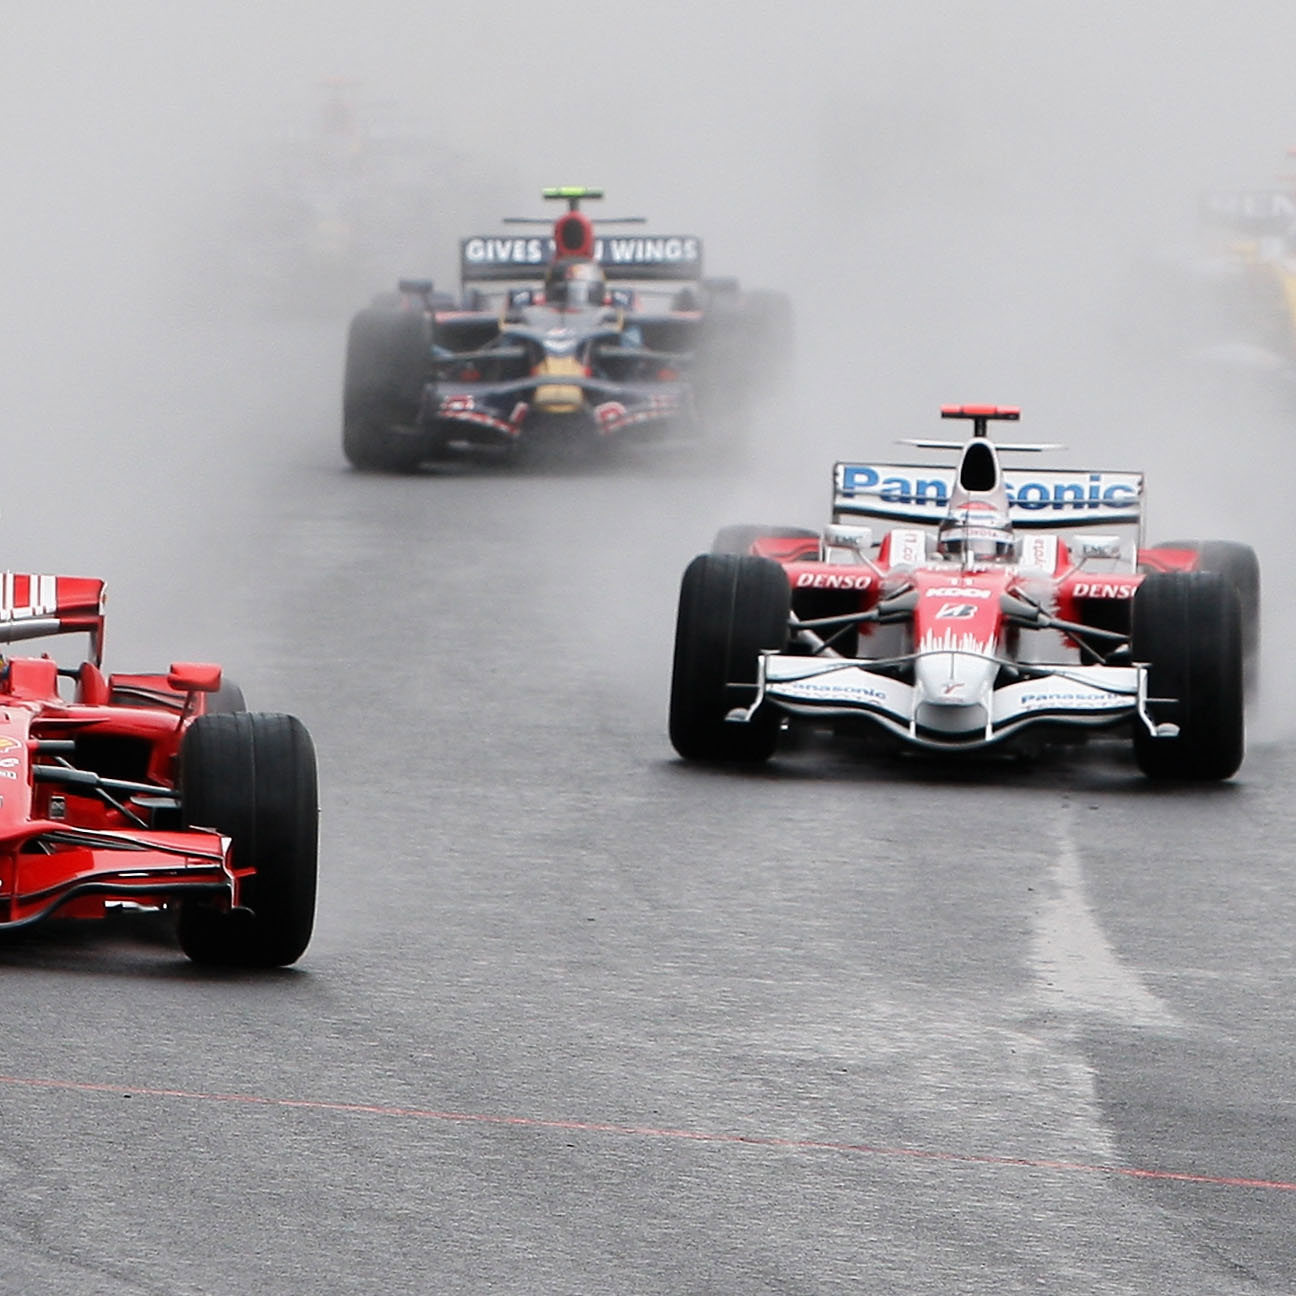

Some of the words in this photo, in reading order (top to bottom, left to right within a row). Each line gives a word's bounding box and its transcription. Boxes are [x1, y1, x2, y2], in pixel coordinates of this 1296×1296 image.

[465, 238, 542, 263] GIVES
[609, 238, 698, 262] WINGS
[843, 466, 1136, 510] Panonic
[797, 573, 872, 589] DENSO
